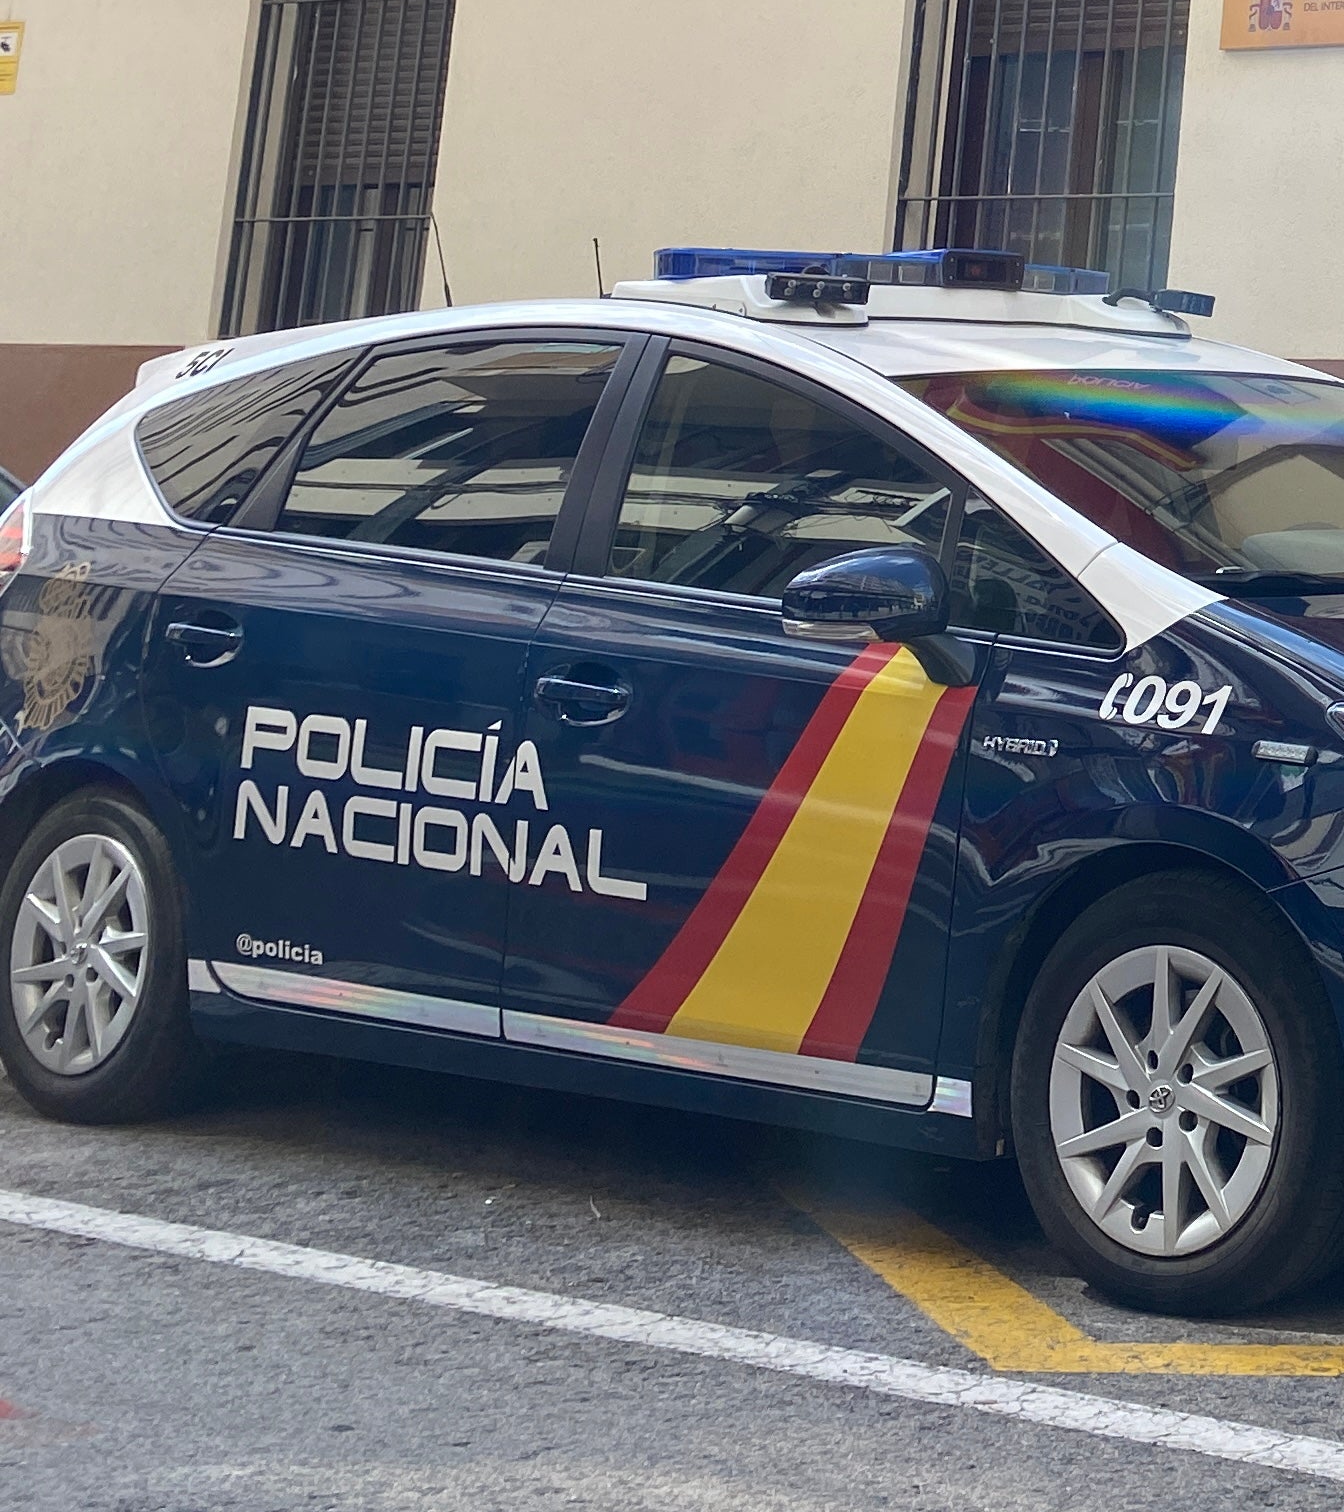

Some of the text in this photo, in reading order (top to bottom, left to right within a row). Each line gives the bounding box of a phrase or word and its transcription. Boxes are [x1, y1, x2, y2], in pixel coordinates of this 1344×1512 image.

[1304, 2, 1319, 12] DEL
[1122, 675, 1232, 735] 091
[240, 706, 548, 810] POLICÍA
[233, 779, 647, 901] NACIONAL
[236, 934, 323, 965] @policia
